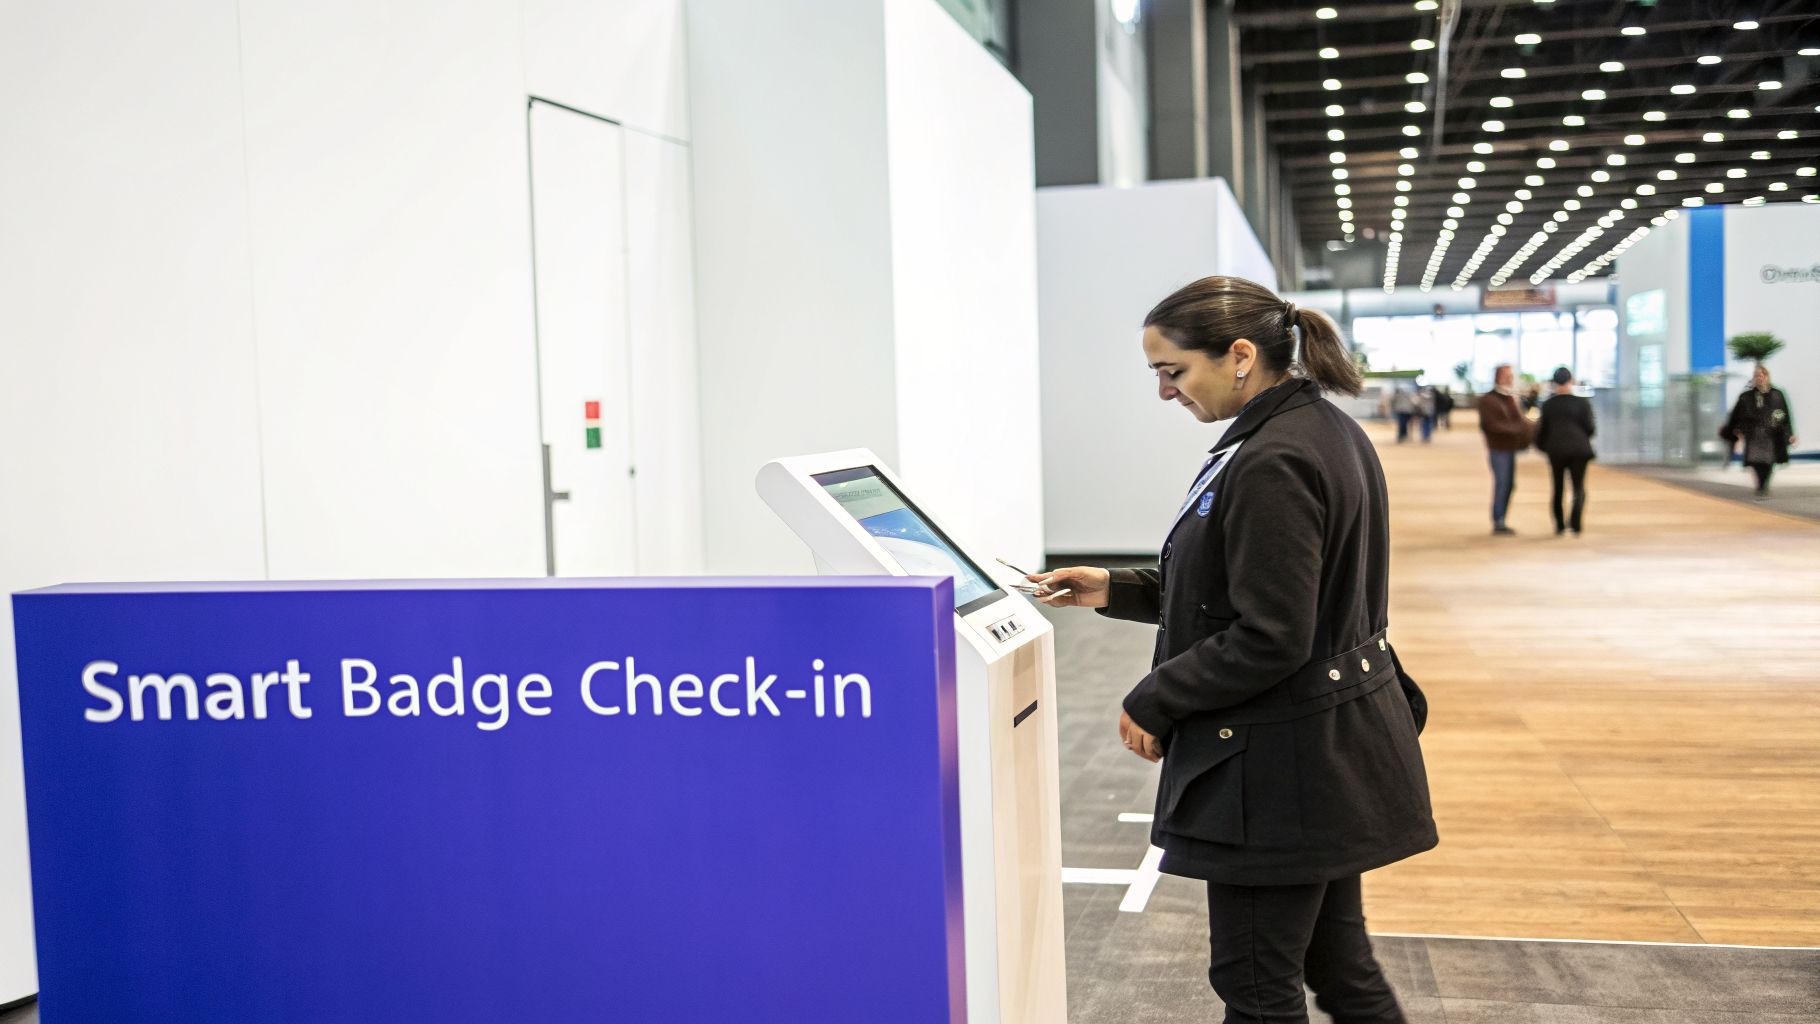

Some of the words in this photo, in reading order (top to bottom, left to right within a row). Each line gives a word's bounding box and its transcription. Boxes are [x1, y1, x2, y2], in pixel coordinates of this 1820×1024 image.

[81, 659, 313, 723] Smart
[340, 656, 553, 731] Badge
[580, 656, 872, 718] Check-in
